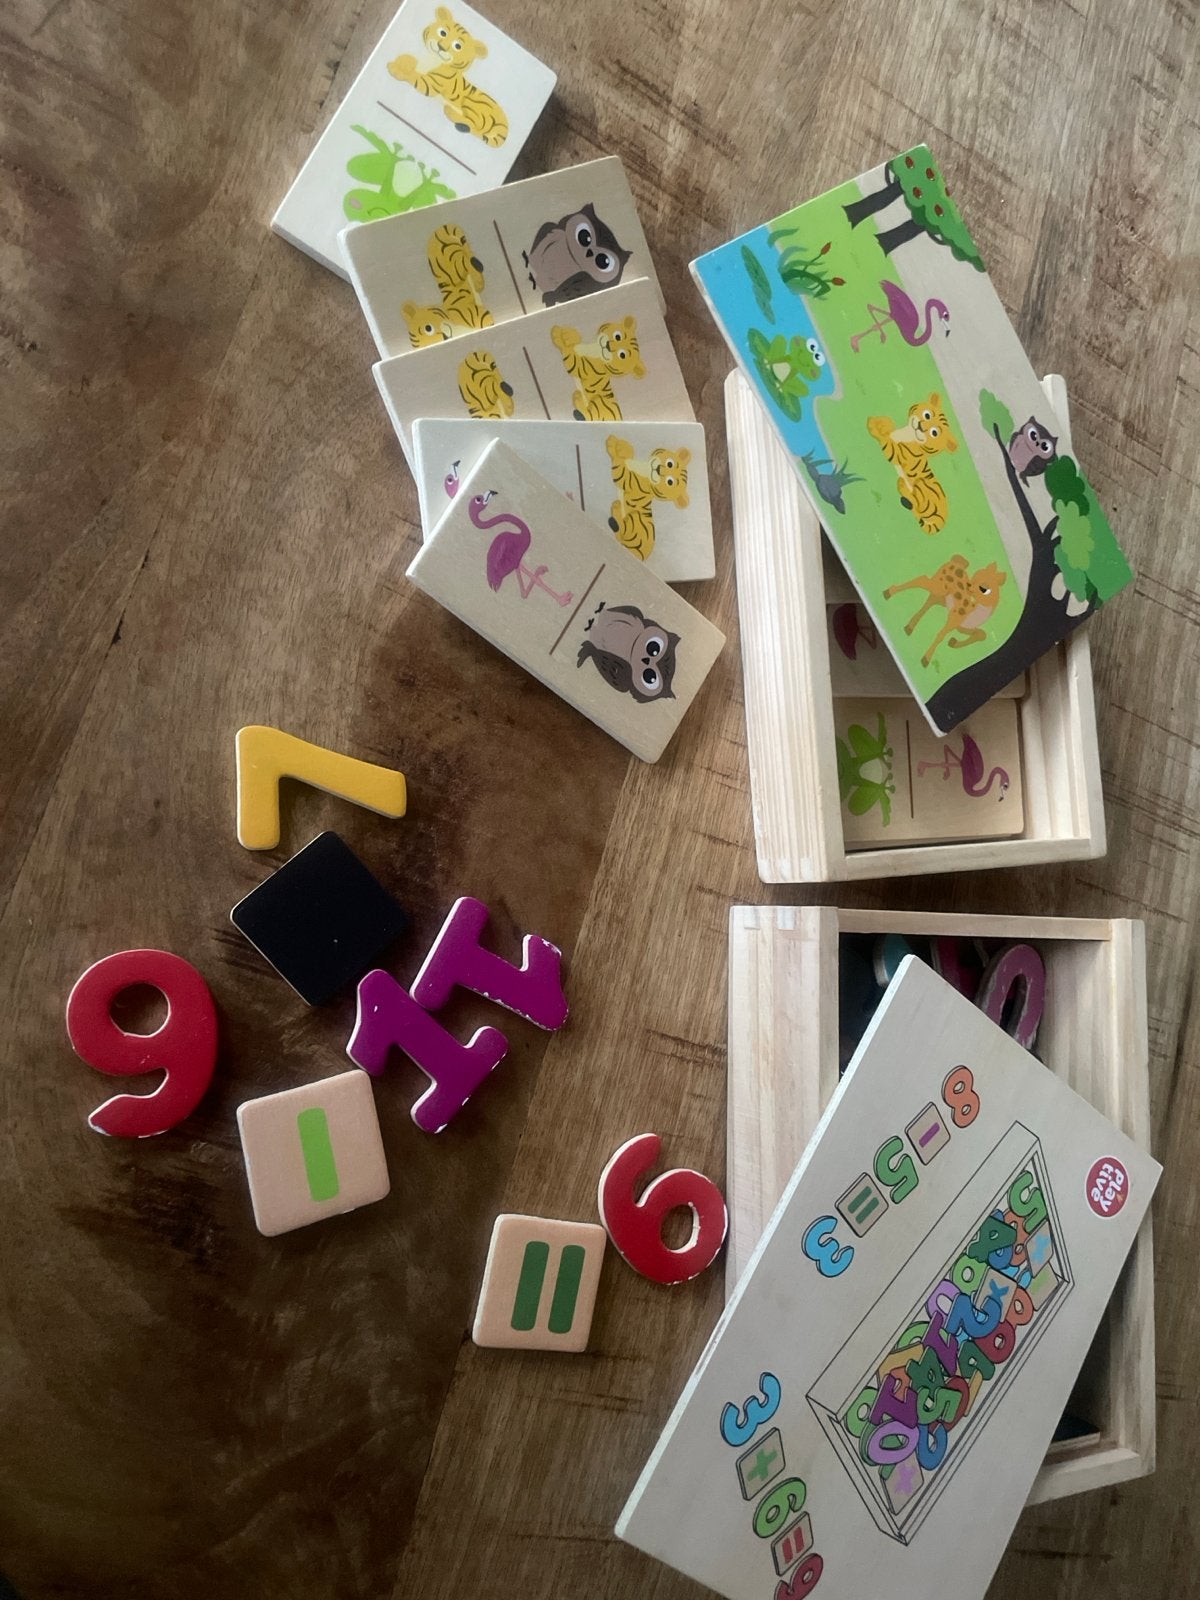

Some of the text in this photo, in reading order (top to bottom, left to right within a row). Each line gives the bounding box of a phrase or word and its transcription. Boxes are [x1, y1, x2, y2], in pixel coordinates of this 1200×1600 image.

[236, 725, 407, 850] 7
[65, 948, 219, 1138] 9
[941, 1065, 980, 1128] 8
[873, 1135, 919, 1204] 5
[1090, 1163, 1114, 1202] tive
[1099, 1168, 1125, 1213] Play
[598, 1132, 729, 1286] 6
[801, 1215, 855, 1278] 3
[720, 1372, 781, 1447] 3
[752, 1477, 807, 1538] 6
